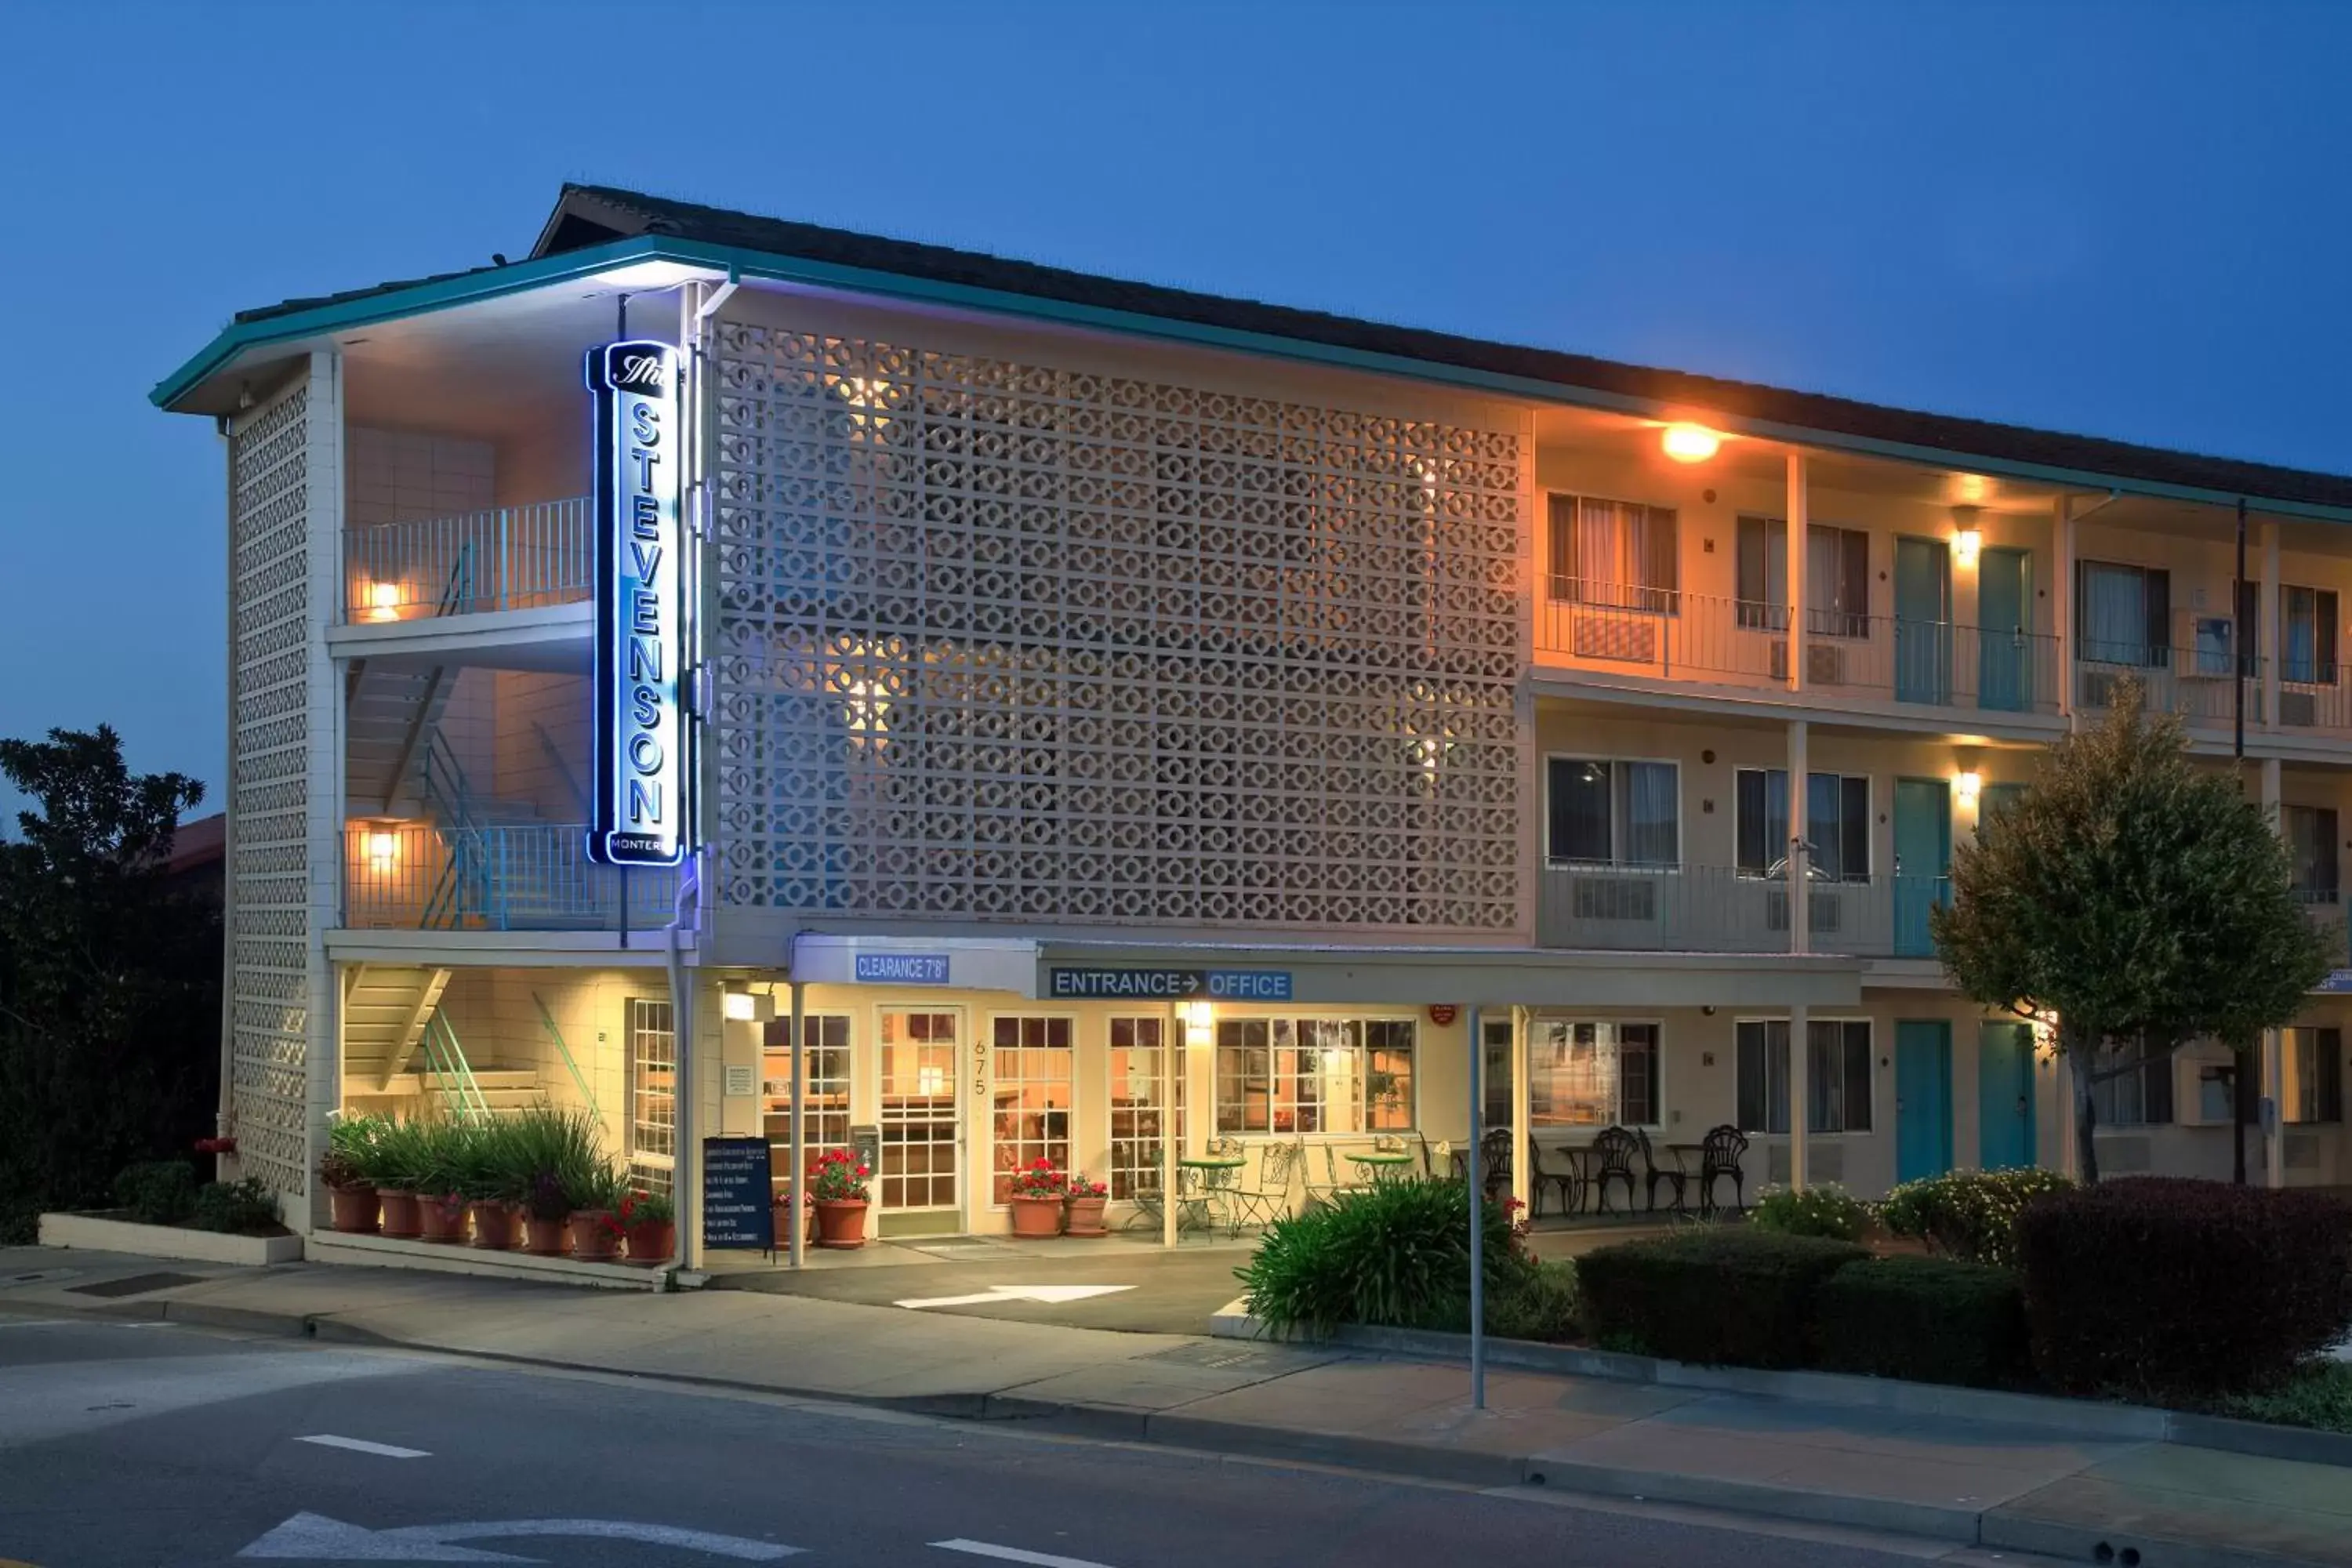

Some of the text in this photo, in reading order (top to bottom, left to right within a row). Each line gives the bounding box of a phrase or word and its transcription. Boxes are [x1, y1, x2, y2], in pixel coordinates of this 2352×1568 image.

[630, 402, 662, 824] STEVENSON
[858, 957, 924, 978] CLEARANCE
[1056, 972, 1287, 996] ENTRANCE OFFICE
[975, 1040, 985, 1095] 675
